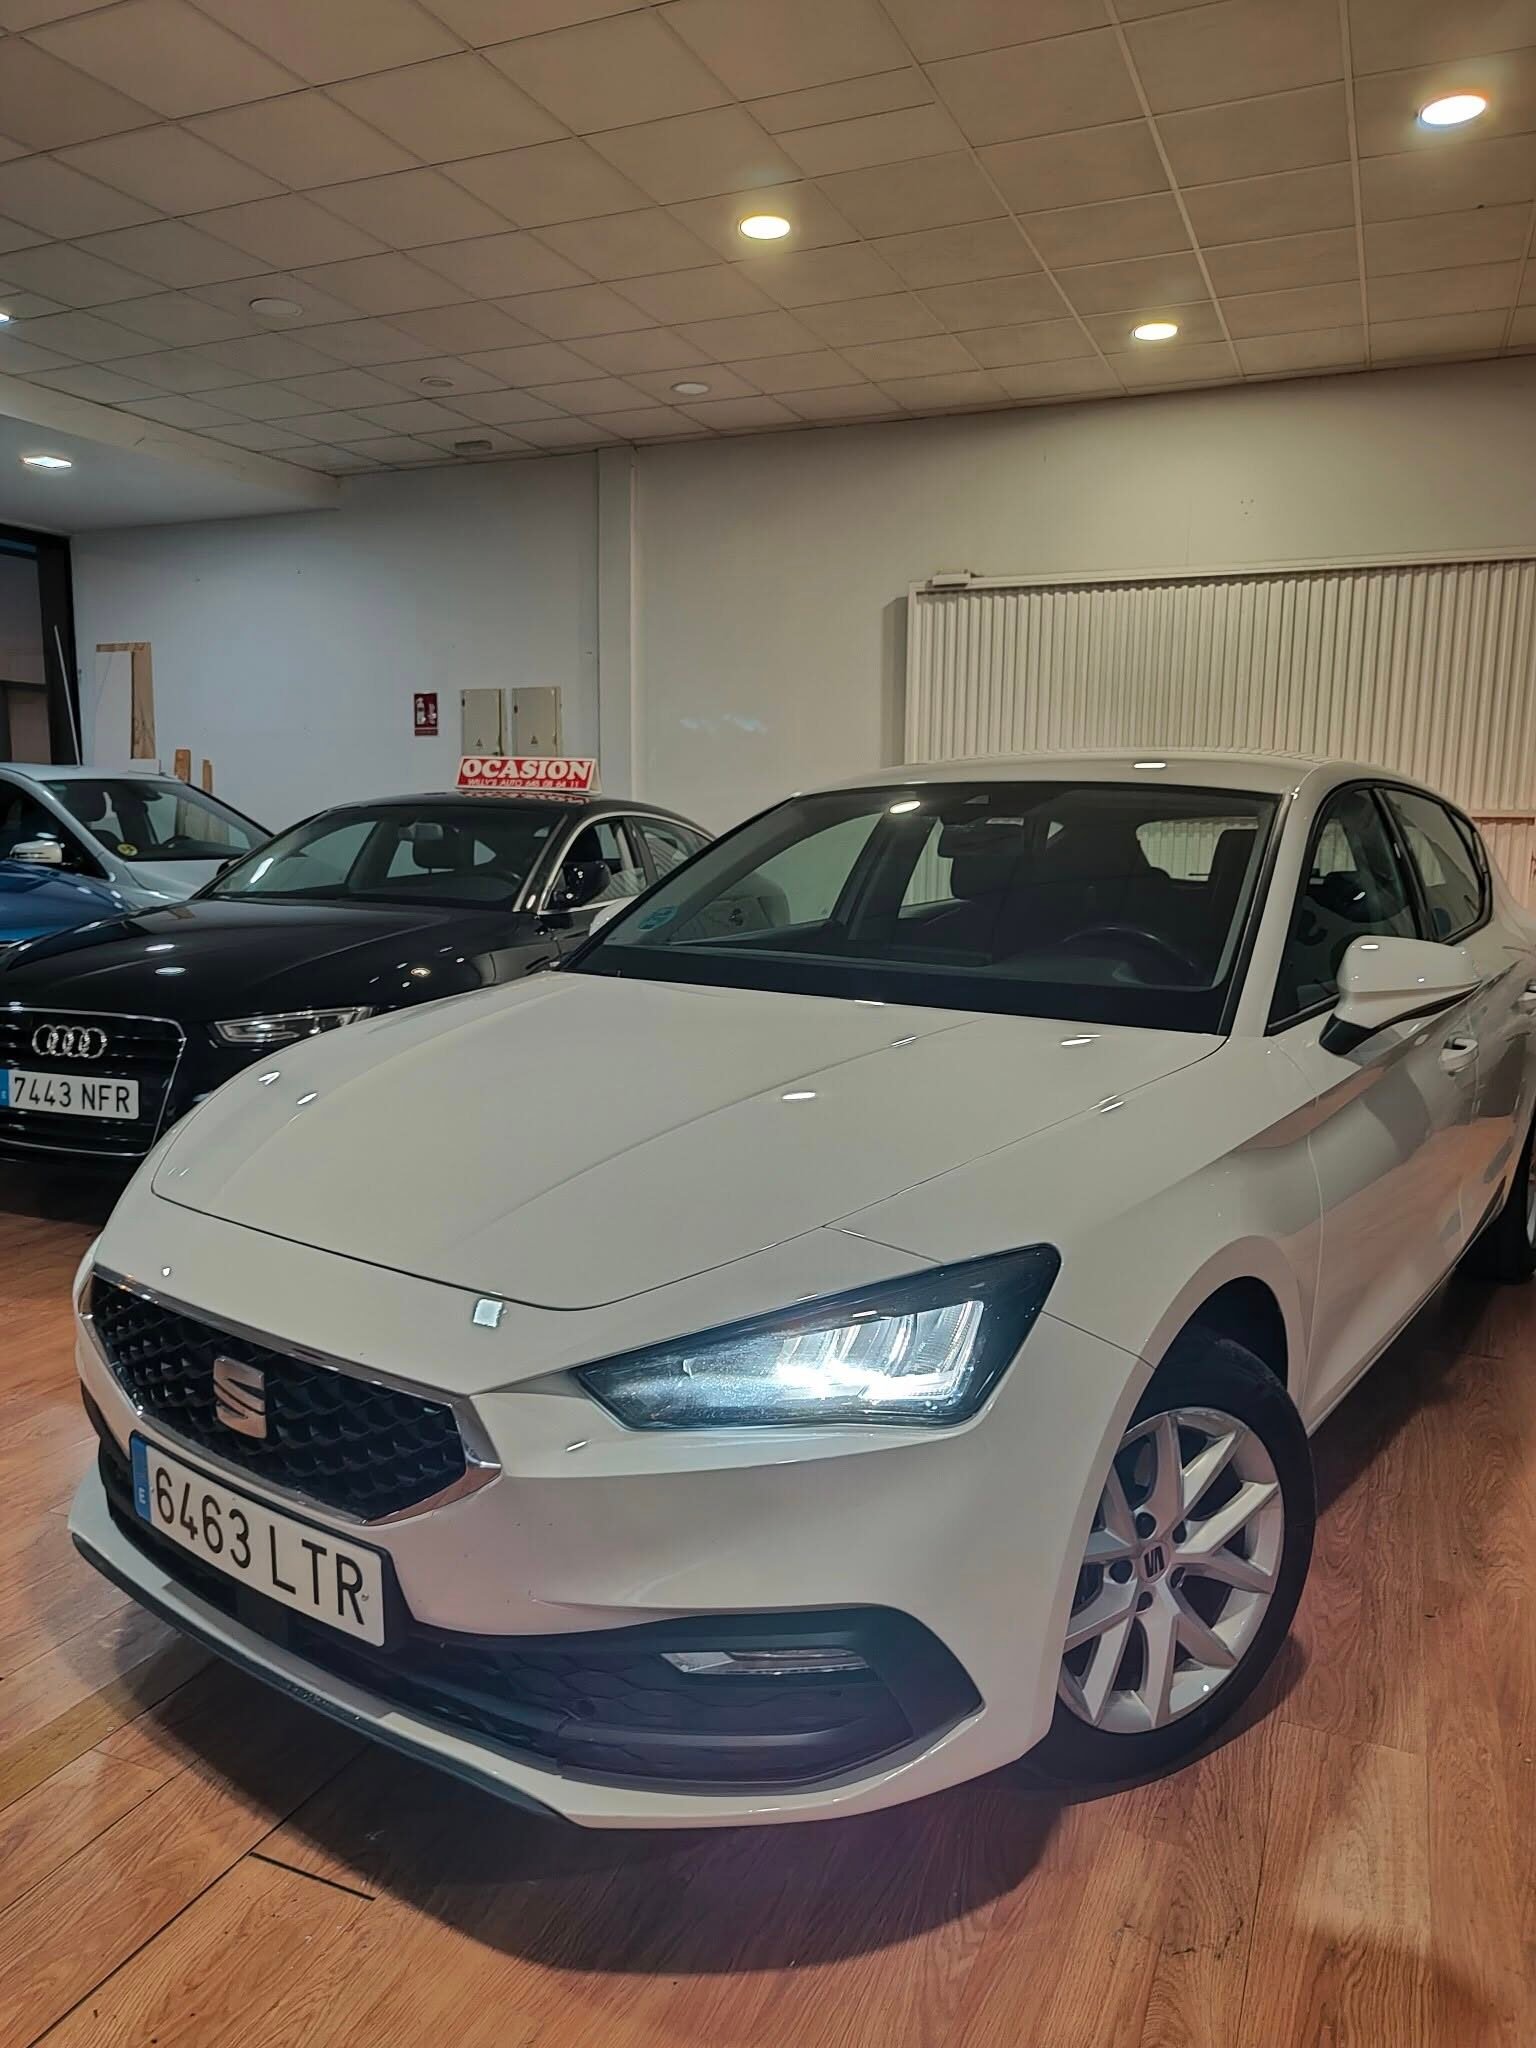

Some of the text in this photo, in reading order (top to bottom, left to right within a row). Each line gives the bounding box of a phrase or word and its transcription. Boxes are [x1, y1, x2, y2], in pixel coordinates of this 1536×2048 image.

[462, 759, 591, 780] OCASION
[499, 779, 523, 787] AUTO
[14, 1077, 130, 1113] 7443 NFR
[156, 1467, 364, 1626] 6463 LTR
